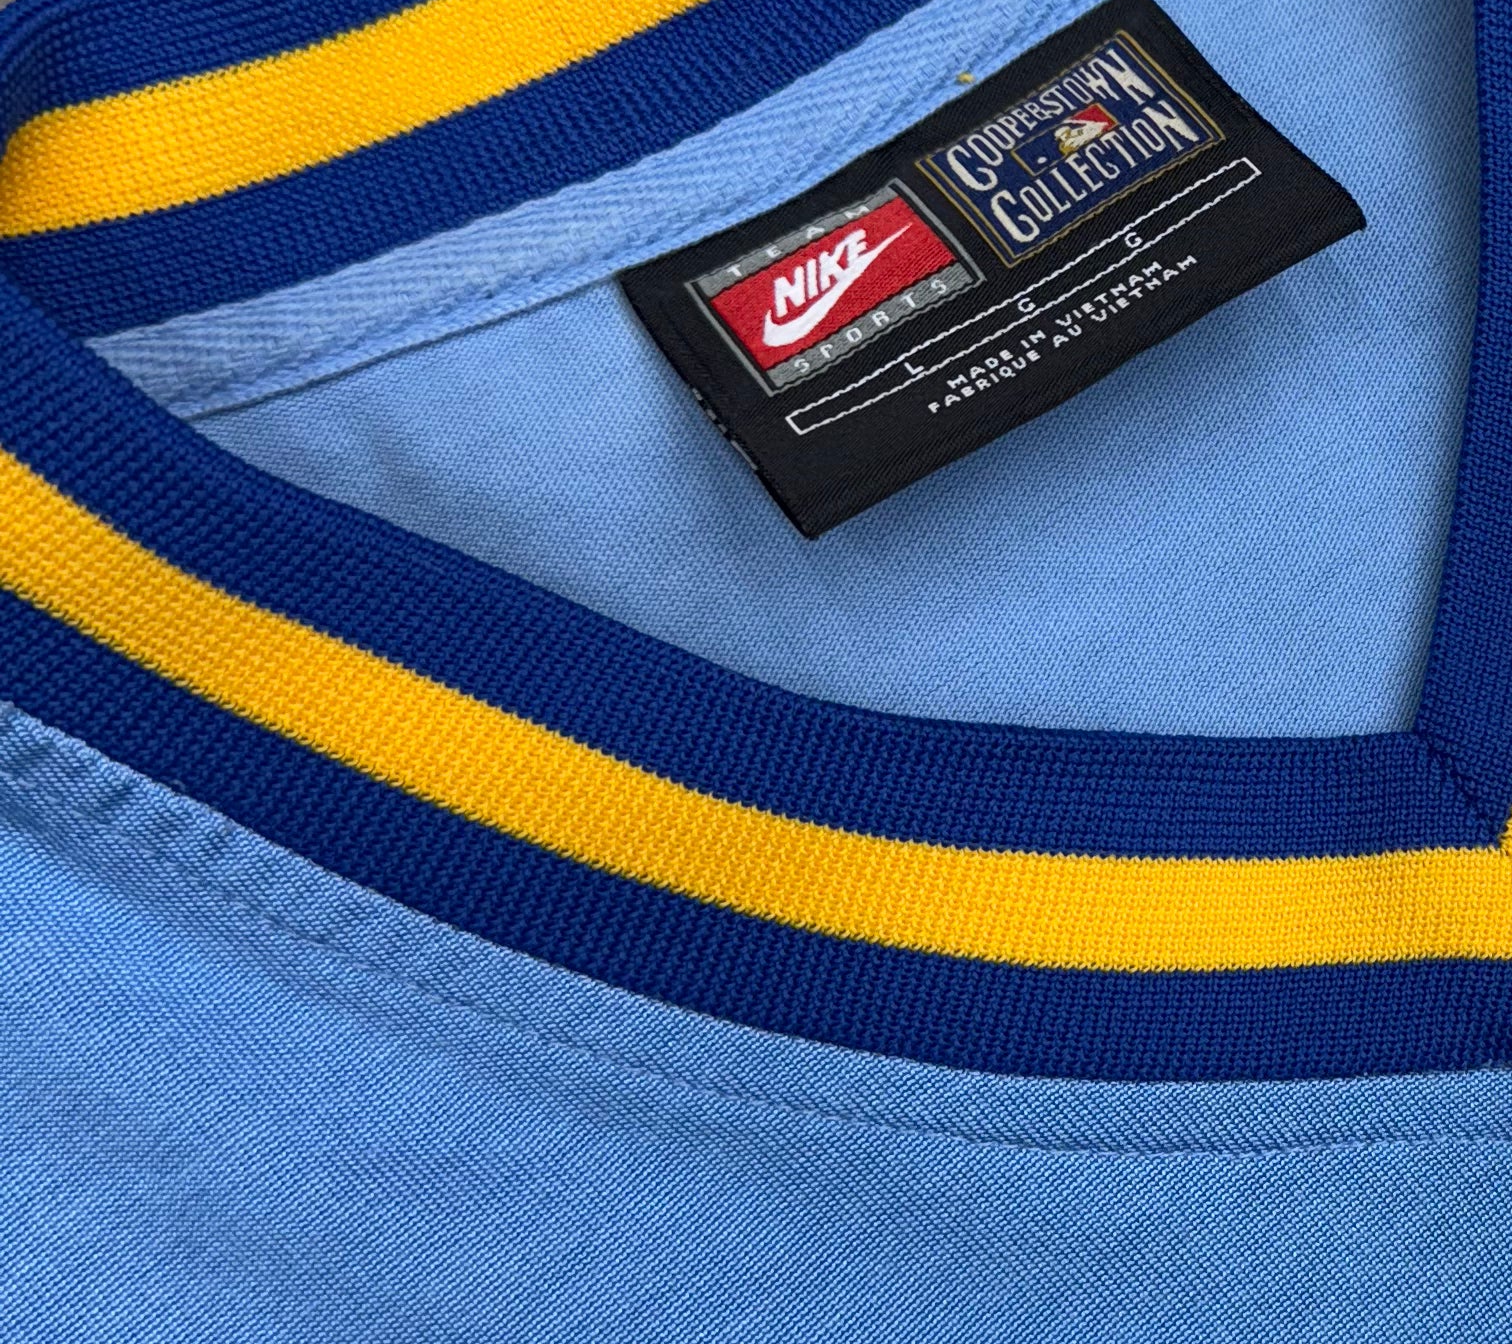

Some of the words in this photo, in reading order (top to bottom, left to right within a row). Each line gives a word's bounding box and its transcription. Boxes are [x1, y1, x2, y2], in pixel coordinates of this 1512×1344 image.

[946, 48, 1155, 192] COOPERSTOWN
[990, 99, 1199, 243] COLLECTION
[727, 206, 870, 277] TEAM
[774, 228, 868, 318] NIKE
[903, 361, 924, 376] L
[1017, 297, 1036, 314] G
[1124, 231, 1143, 248] G
[794, 279, 947, 373] SPORTS
[928, 349, 1041, 414] FABRIQUE
[1053, 324, 1083, 348] AU
[1091, 255, 1198, 322] VIETNAM
[947, 349, 1014, 390] MADE
[1020, 329, 1047, 349] IN
[1055, 260, 1162, 327] VIETNAM
